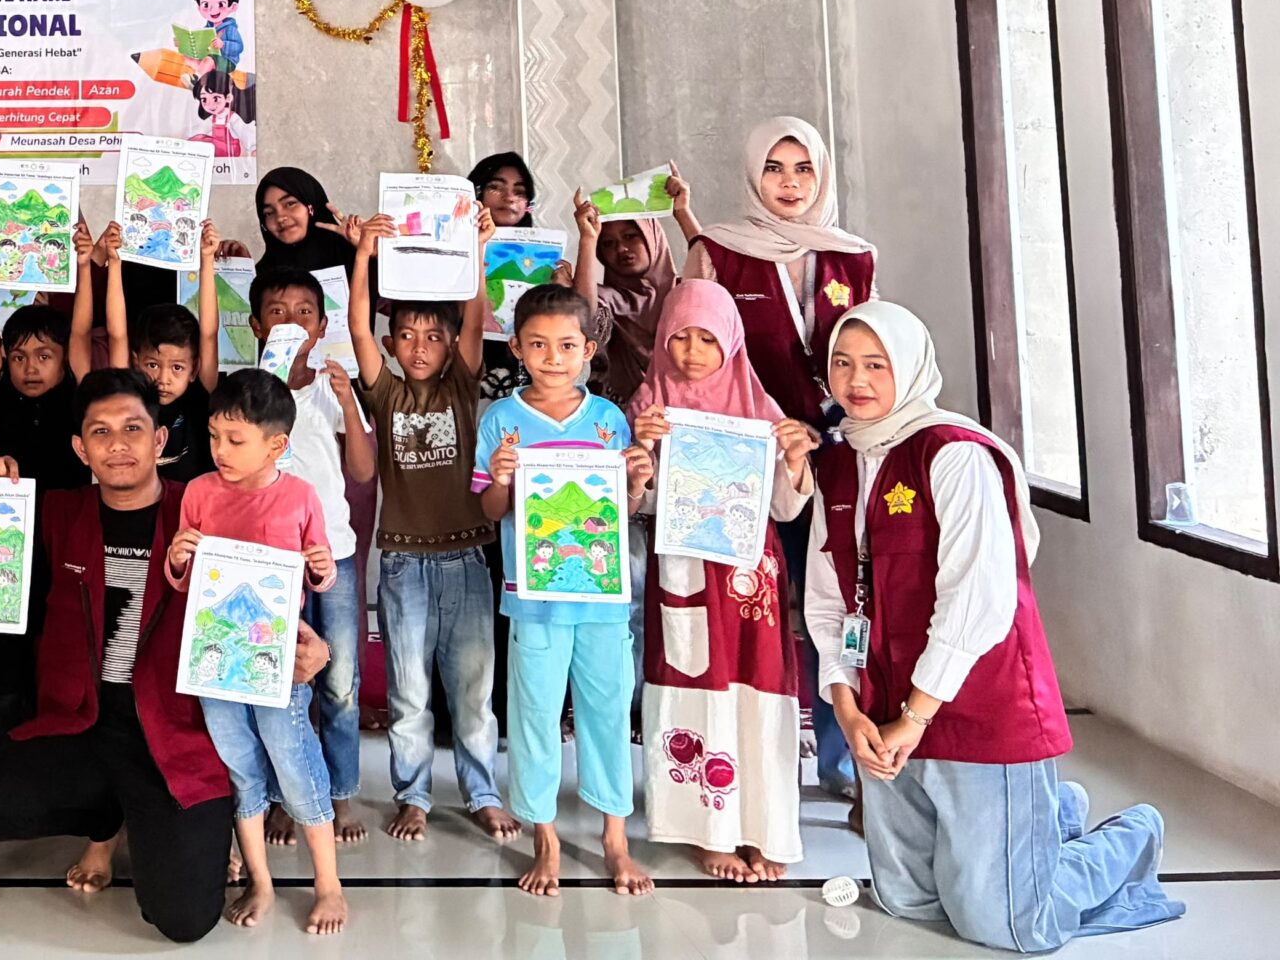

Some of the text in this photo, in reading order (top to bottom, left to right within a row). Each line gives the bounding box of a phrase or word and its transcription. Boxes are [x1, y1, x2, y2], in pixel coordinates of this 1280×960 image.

[45, 47, 82, 58] Hebat"
[25, 85, 71, 97] Pendek
[88, 85, 120, 96] Azan
[48, 111, 81, 125] Cepat
[10, 136, 66, 146] Meunasah
[68, 135, 96, 146] Desa
[103, 545, 133, 557] MPORIO
